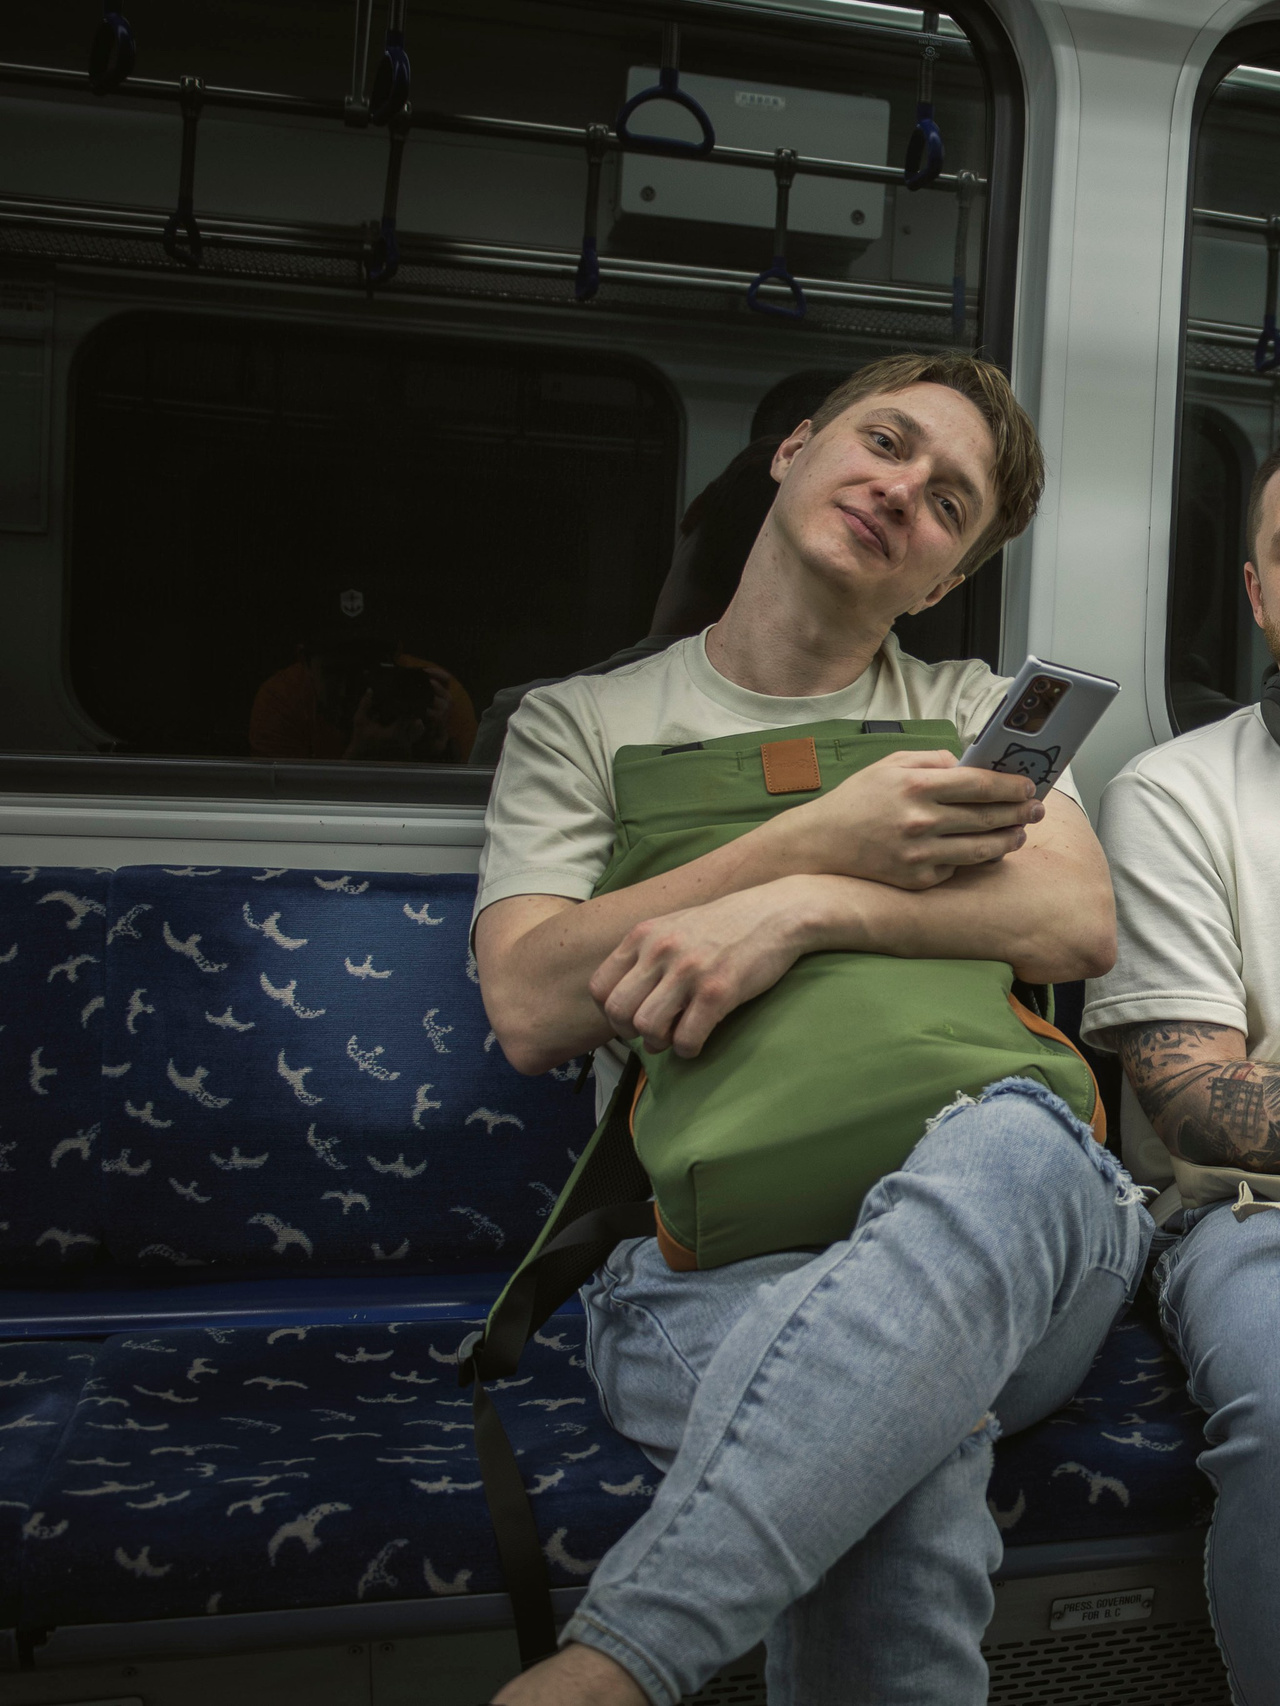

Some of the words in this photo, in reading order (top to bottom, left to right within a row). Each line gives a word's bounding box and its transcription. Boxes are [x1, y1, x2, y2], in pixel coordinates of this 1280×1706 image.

[1064, 1601, 1093, 1613] PRESS.
[1096, 1594, 1142, 1609] GOVERNOR
[1081, 1611, 1099, 1621] FOR
